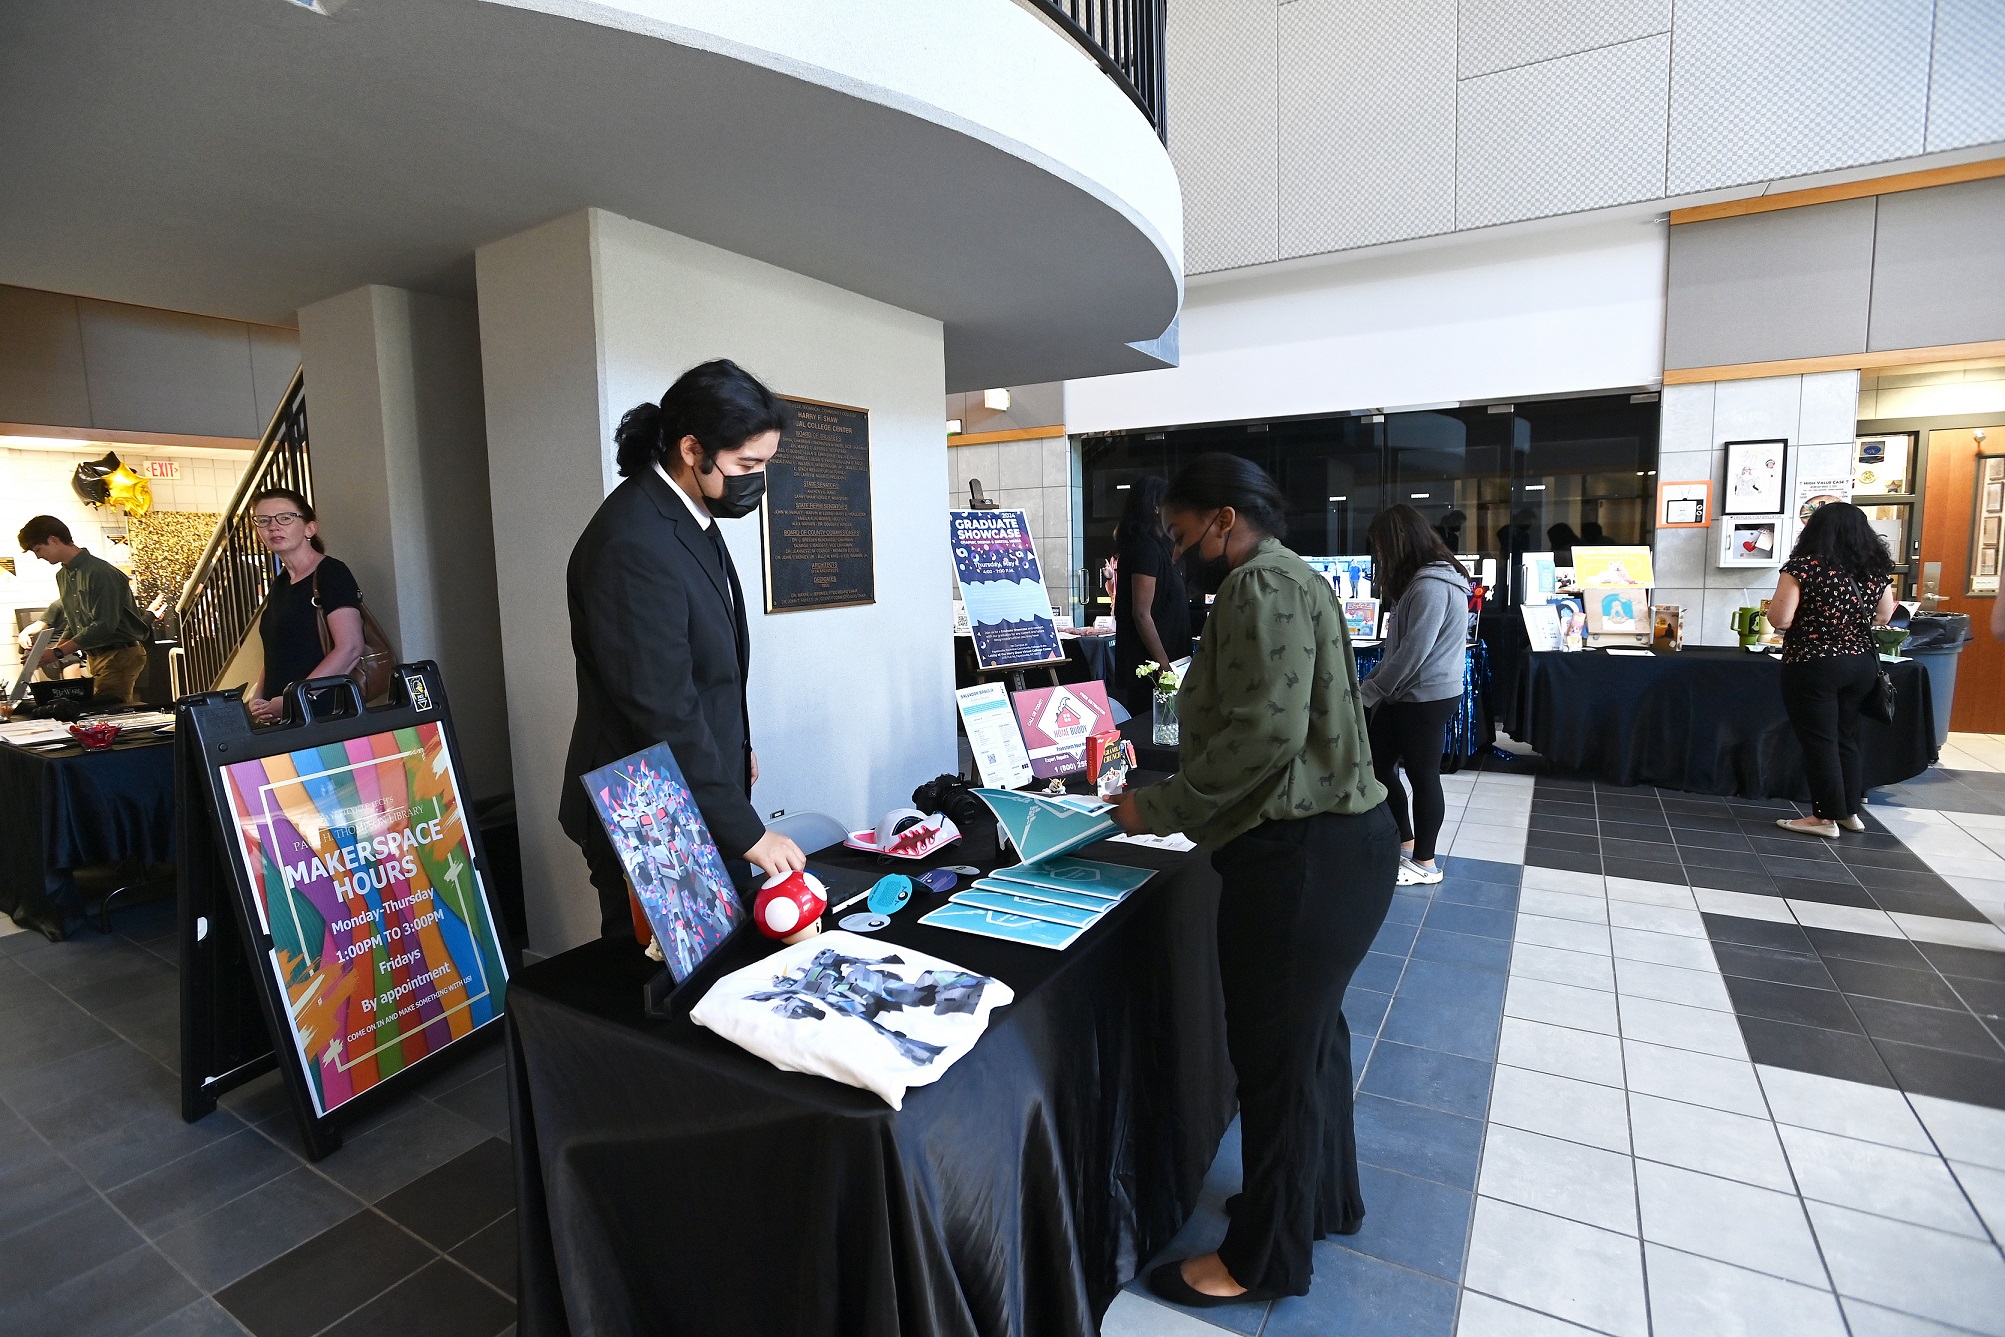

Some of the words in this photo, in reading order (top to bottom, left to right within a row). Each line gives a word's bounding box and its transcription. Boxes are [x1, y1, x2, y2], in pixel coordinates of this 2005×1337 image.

[798, 412, 816, 420] HARRY
[823, 416, 838, 424] SHAW
[807, 420, 831, 432] COLLEGE
[832, 425, 853, 434] CENTER
[151, 462, 175, 478] EXIT
[955, 518, 1018, 529] GRADUATE
[957, 529, 1021, 540] SHOWCASE
[1054, 728, 1070, 738] HOME
[1070, 725, 1088, 735] BUDDY
[1060, 763, 1076, 773] (800)
[334, 816, 389, 839] THOMPSON
[389, 805, 424, 824] LIBRARY
[285, 818, 444, 889] MAKERSPACE
[333, 854, 418, 903] HOURS
[332, 888, 434, 935] Monday-Thursday
[336, 934, 383, 964] 1:00PM
[383, 928, 401, 943] TO
[402, 908, 444, 936] 3:00PM
[379, 949, 422, 975] Fridays
[361, 996, 377, 1014] By
[380, 961, 451, 1004] appointment
[347, 1029, 366, 1043] COME
[366, 1024, 376, 1032] ON
[376, 1019, 385, 1028] IN
[385, 1012, 399, 1024] AND
[398, 1004, 416, 1017] MAKE
[415, 988, 448, 1009] SOMETHING
[448, 980, 463, 992] WITH
